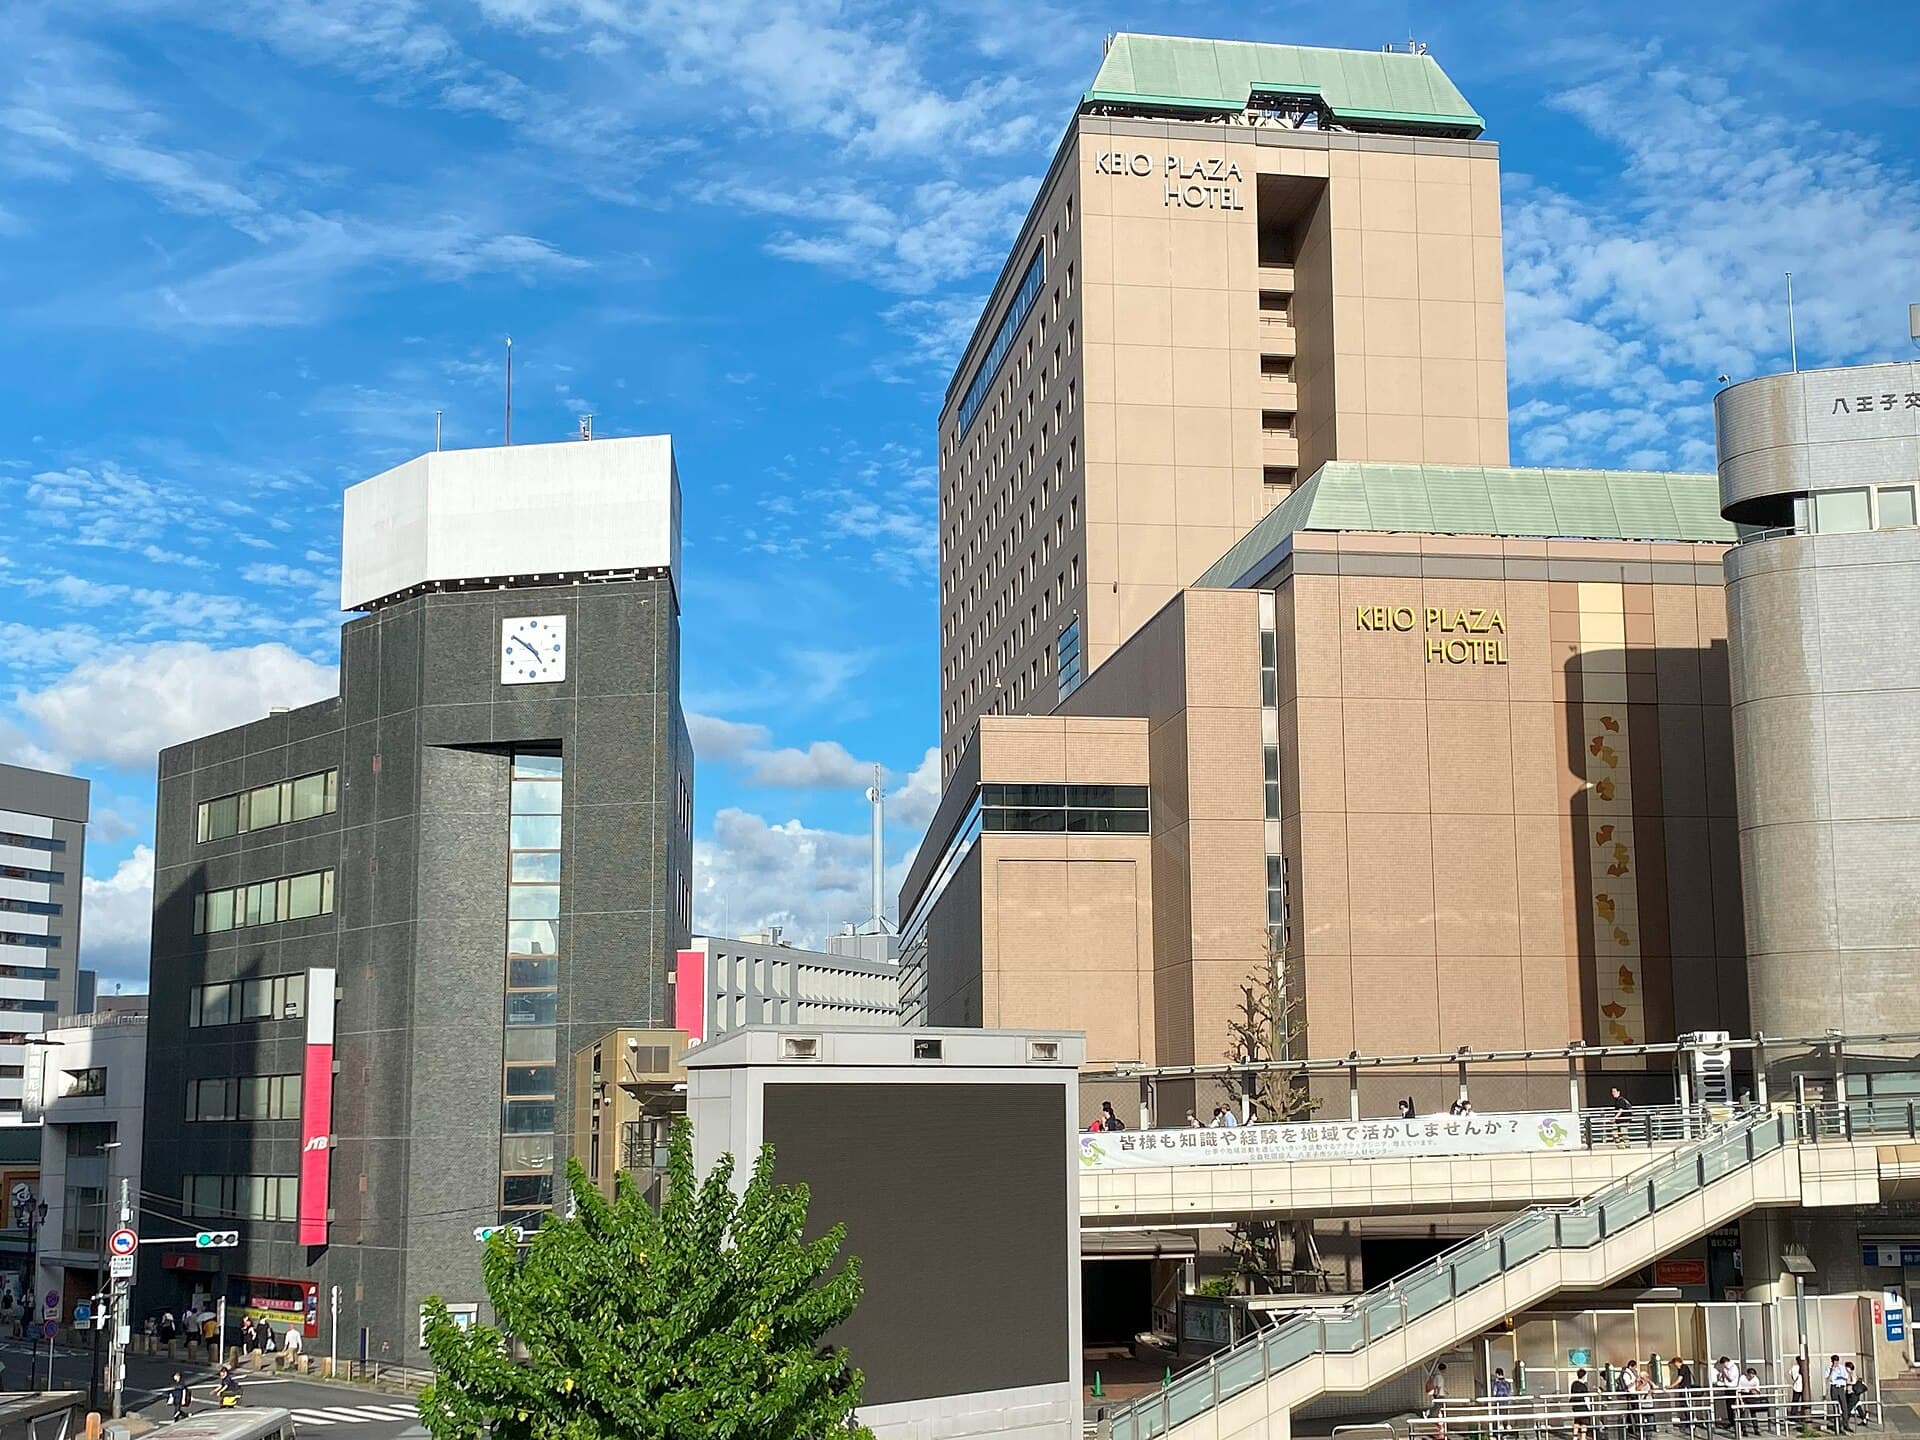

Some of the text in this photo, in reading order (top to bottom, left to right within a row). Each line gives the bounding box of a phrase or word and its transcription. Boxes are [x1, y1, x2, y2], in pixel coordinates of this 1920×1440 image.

[1095, 151, 1243, 183] KEIO PLAZA
[1164, 183, 1244, 211] HOTEL
[1356, 605, 1506, 634] KEIO PLAZA
[1426, 638, 1509, 665] HOTEL
[303, 1135, 329, 1152] JTB
[1119, 1120, 1519, 1151] 皆様も知識や経験を地域で活かしませんか？
